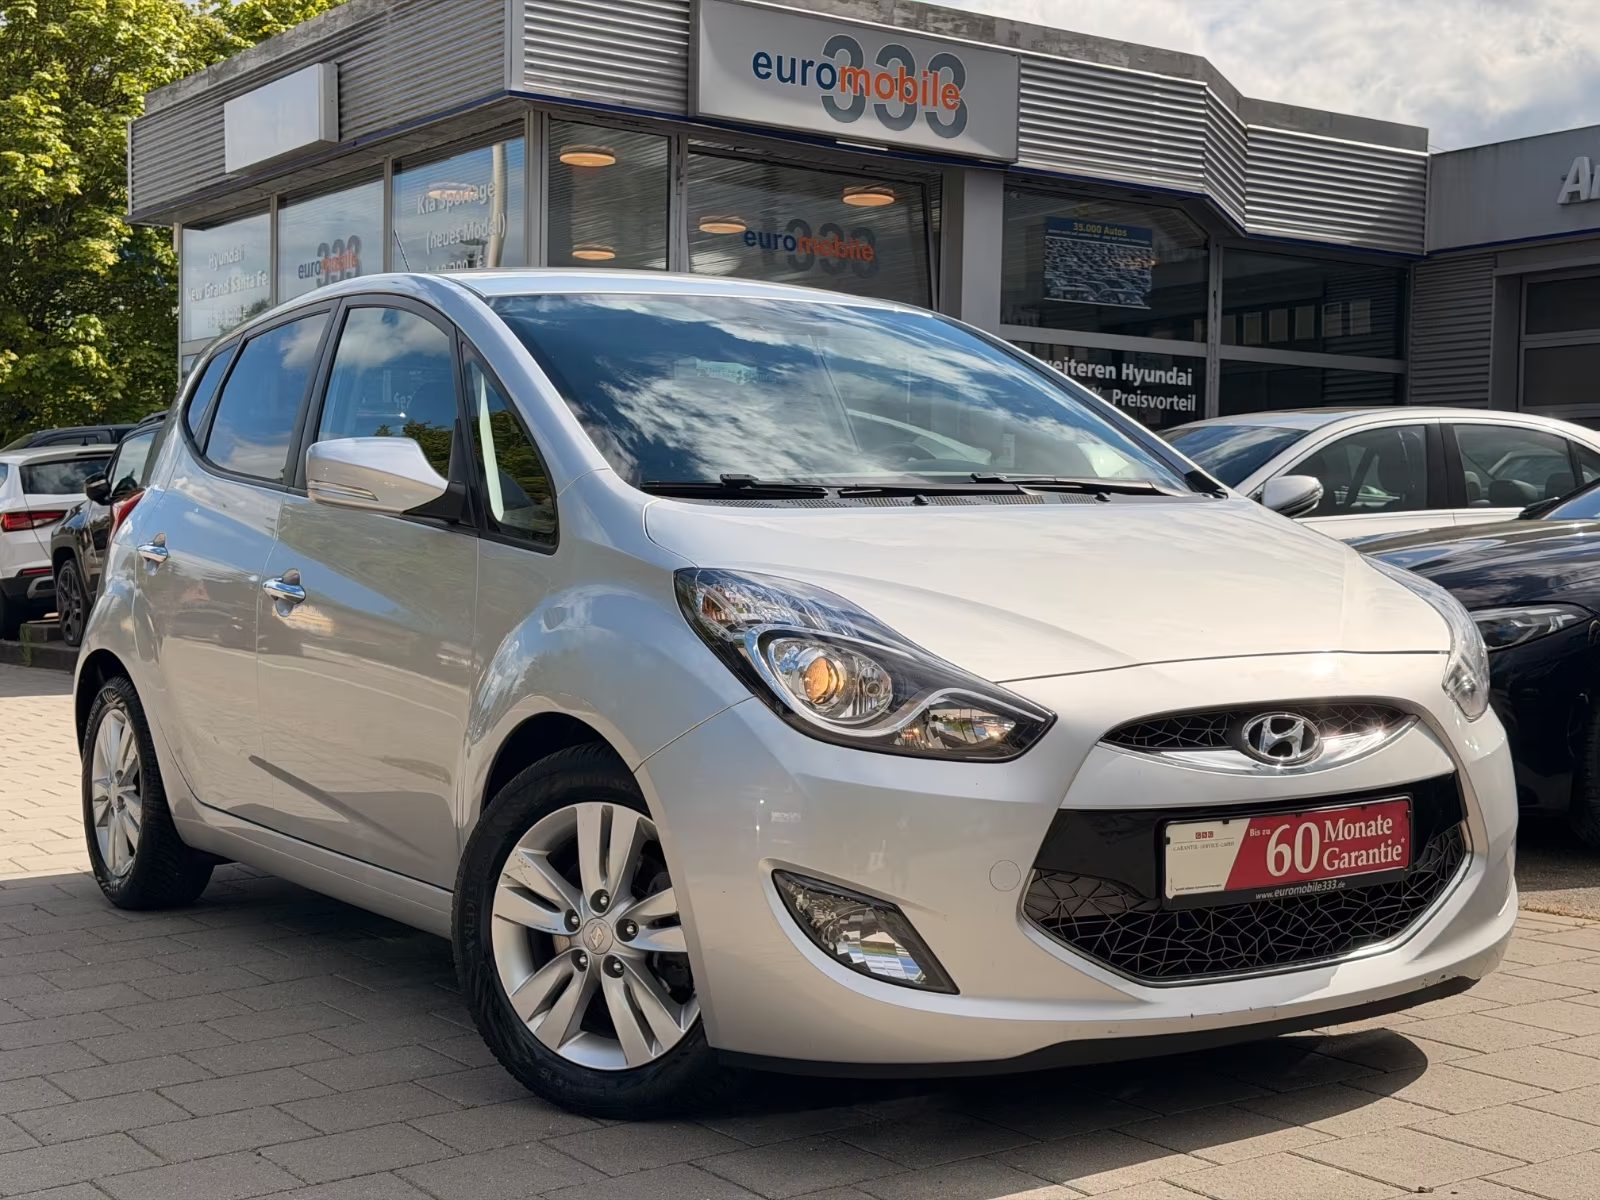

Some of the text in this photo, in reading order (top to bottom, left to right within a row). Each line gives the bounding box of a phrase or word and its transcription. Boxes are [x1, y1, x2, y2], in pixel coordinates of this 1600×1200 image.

[752, 51, 961, 111] euromobile
[821, 33, 968, 139] 333
[417, 182, 496, 215] Kia Sportage
[426, 230, 460, 255] (neues
[1103, 226, 1128, 237] Autos
[209, 246, 245, 271] Hyundai
[744, 231, 875, 262] euromobile
[1122, 362, 1193, 386] Hyundai
[1112, 388, 1197, 411] Preisvorteil
[1322, 814, 1393, 843] Monate
[1250, 821, 1320, 877] Bis zu 60
[1255, 879, 1346, 900] www.euromobile333.de
